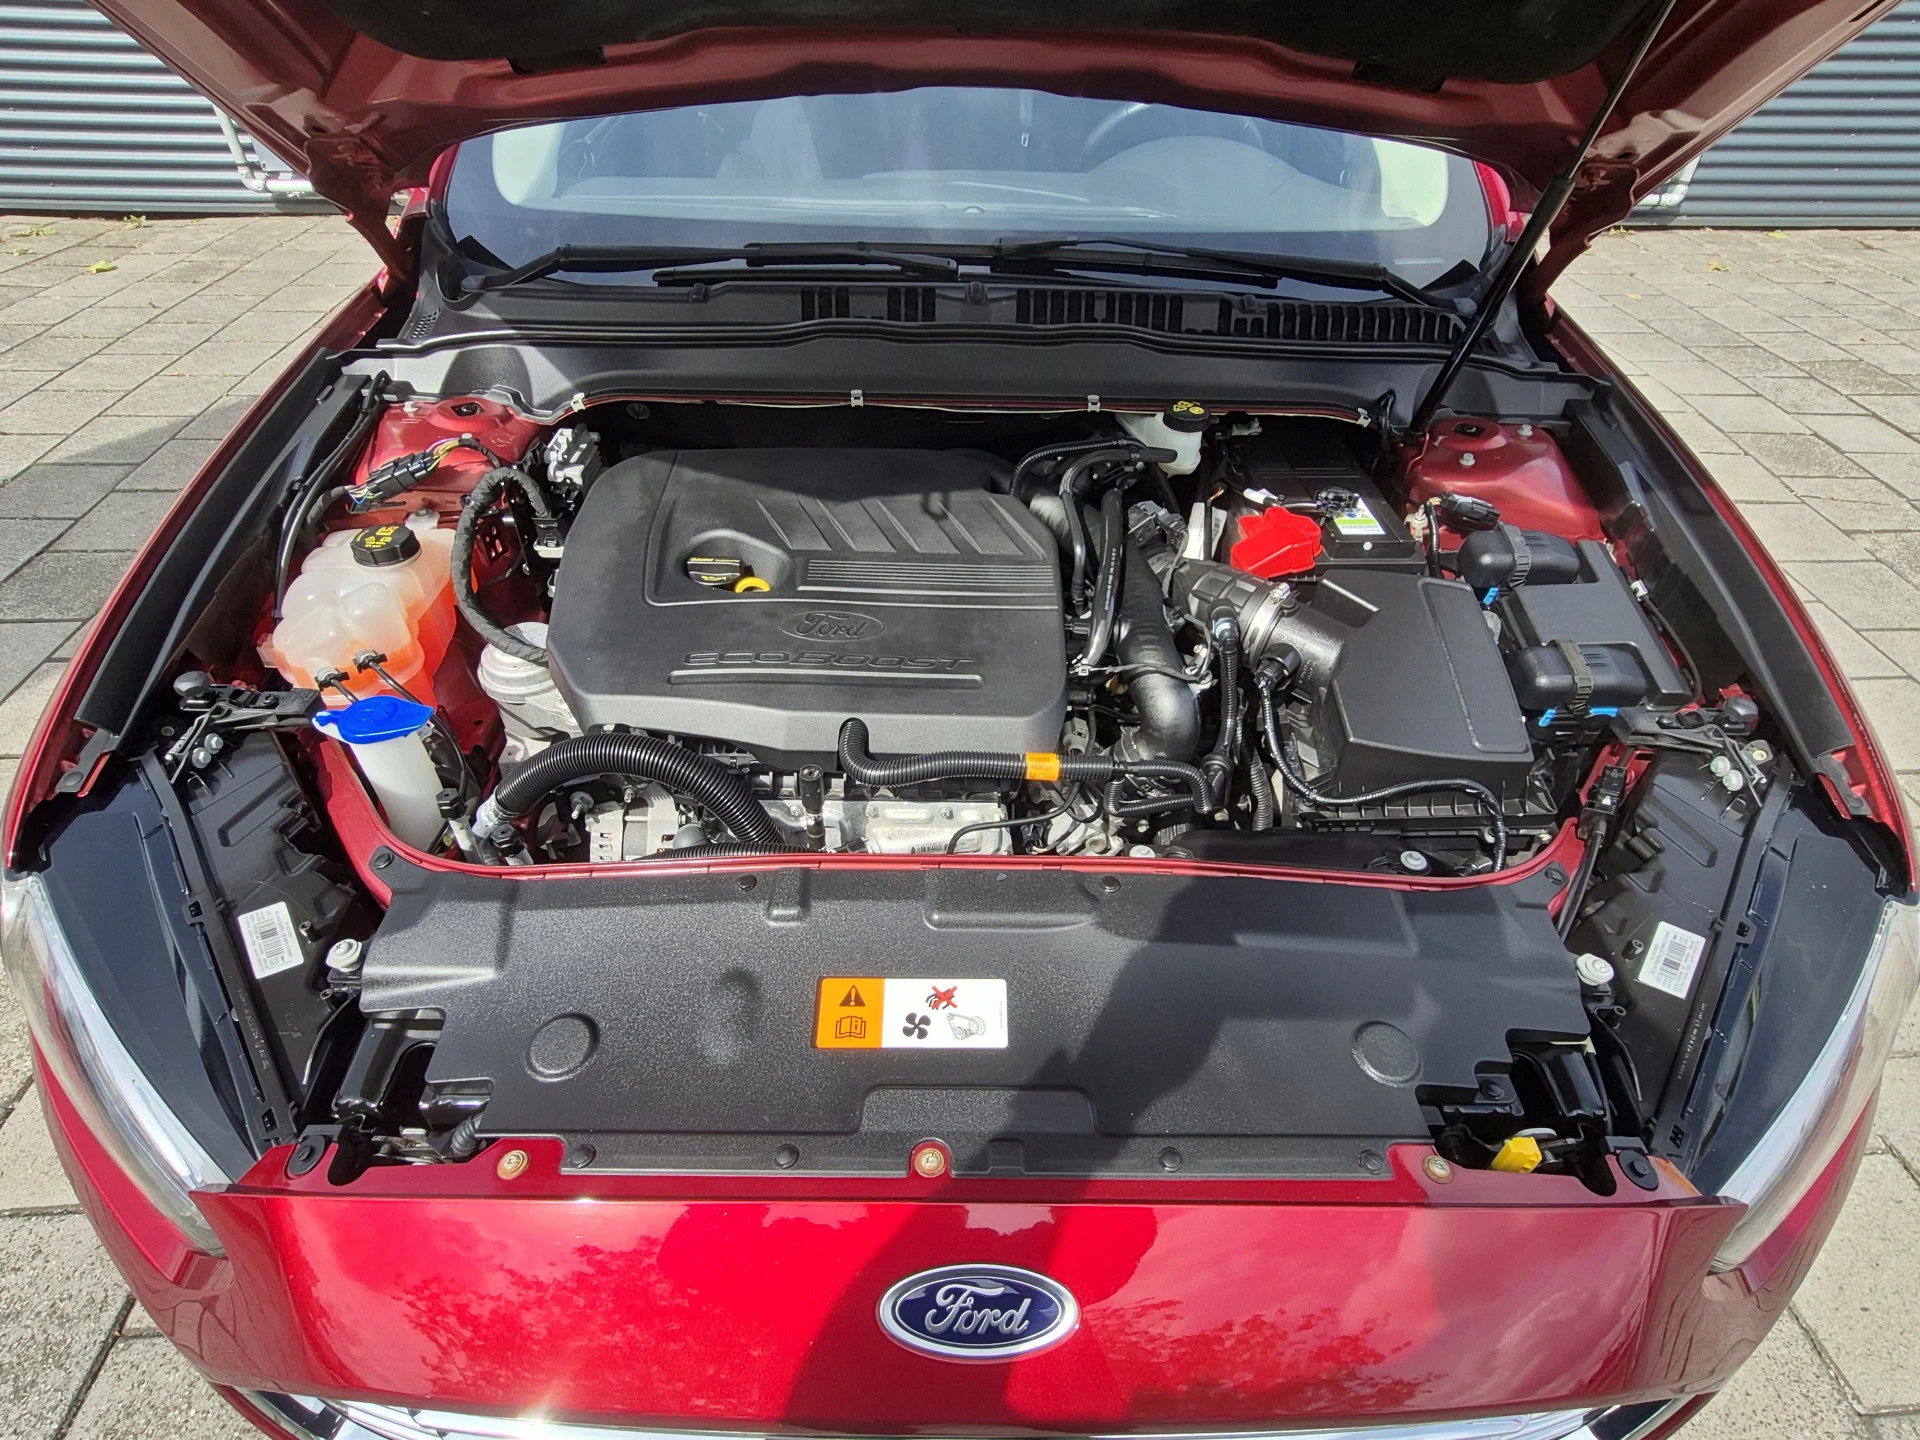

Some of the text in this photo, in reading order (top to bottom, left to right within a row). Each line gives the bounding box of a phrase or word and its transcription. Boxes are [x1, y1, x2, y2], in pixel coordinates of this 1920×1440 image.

[796, 613, 867, 638] Ford
[684, 651, 976, 669] ECOBOOST
[925, 1284, 1032, 1335] Ford
